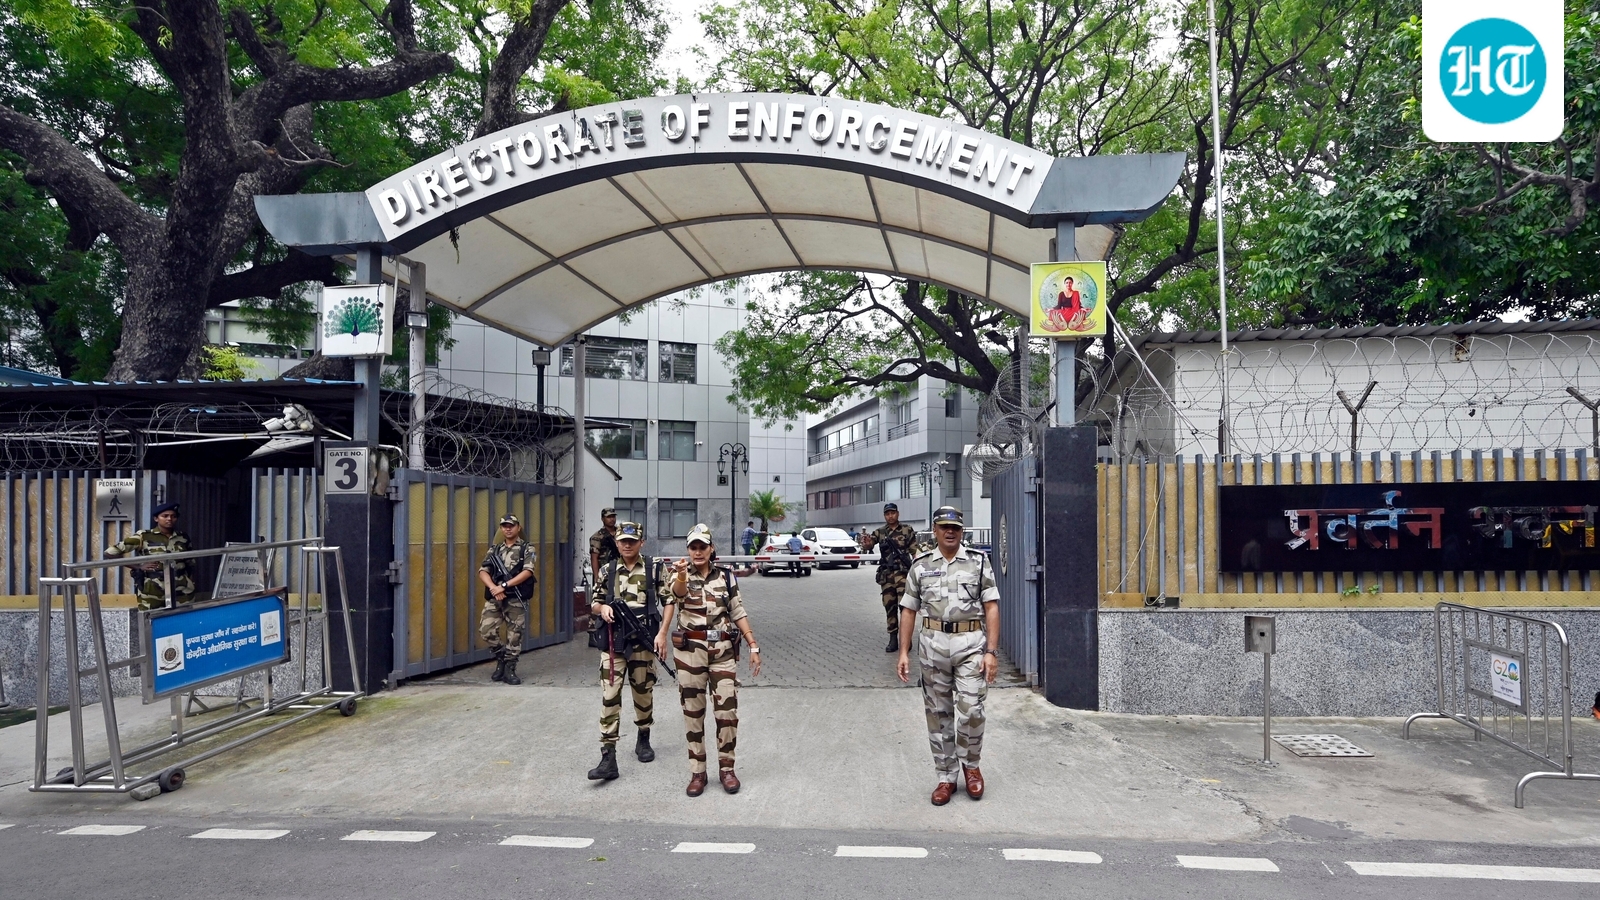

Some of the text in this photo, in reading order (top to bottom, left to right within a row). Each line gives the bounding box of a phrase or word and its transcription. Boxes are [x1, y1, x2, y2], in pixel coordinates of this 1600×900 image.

[379, 101, 1035, 226] DIRECTORATE OF ENFORCEMENT
[334, 457, 359, 490] 3
[719, 476, 727, 484] B
[1284, 490, 1445, 550] प्रवर्तन
